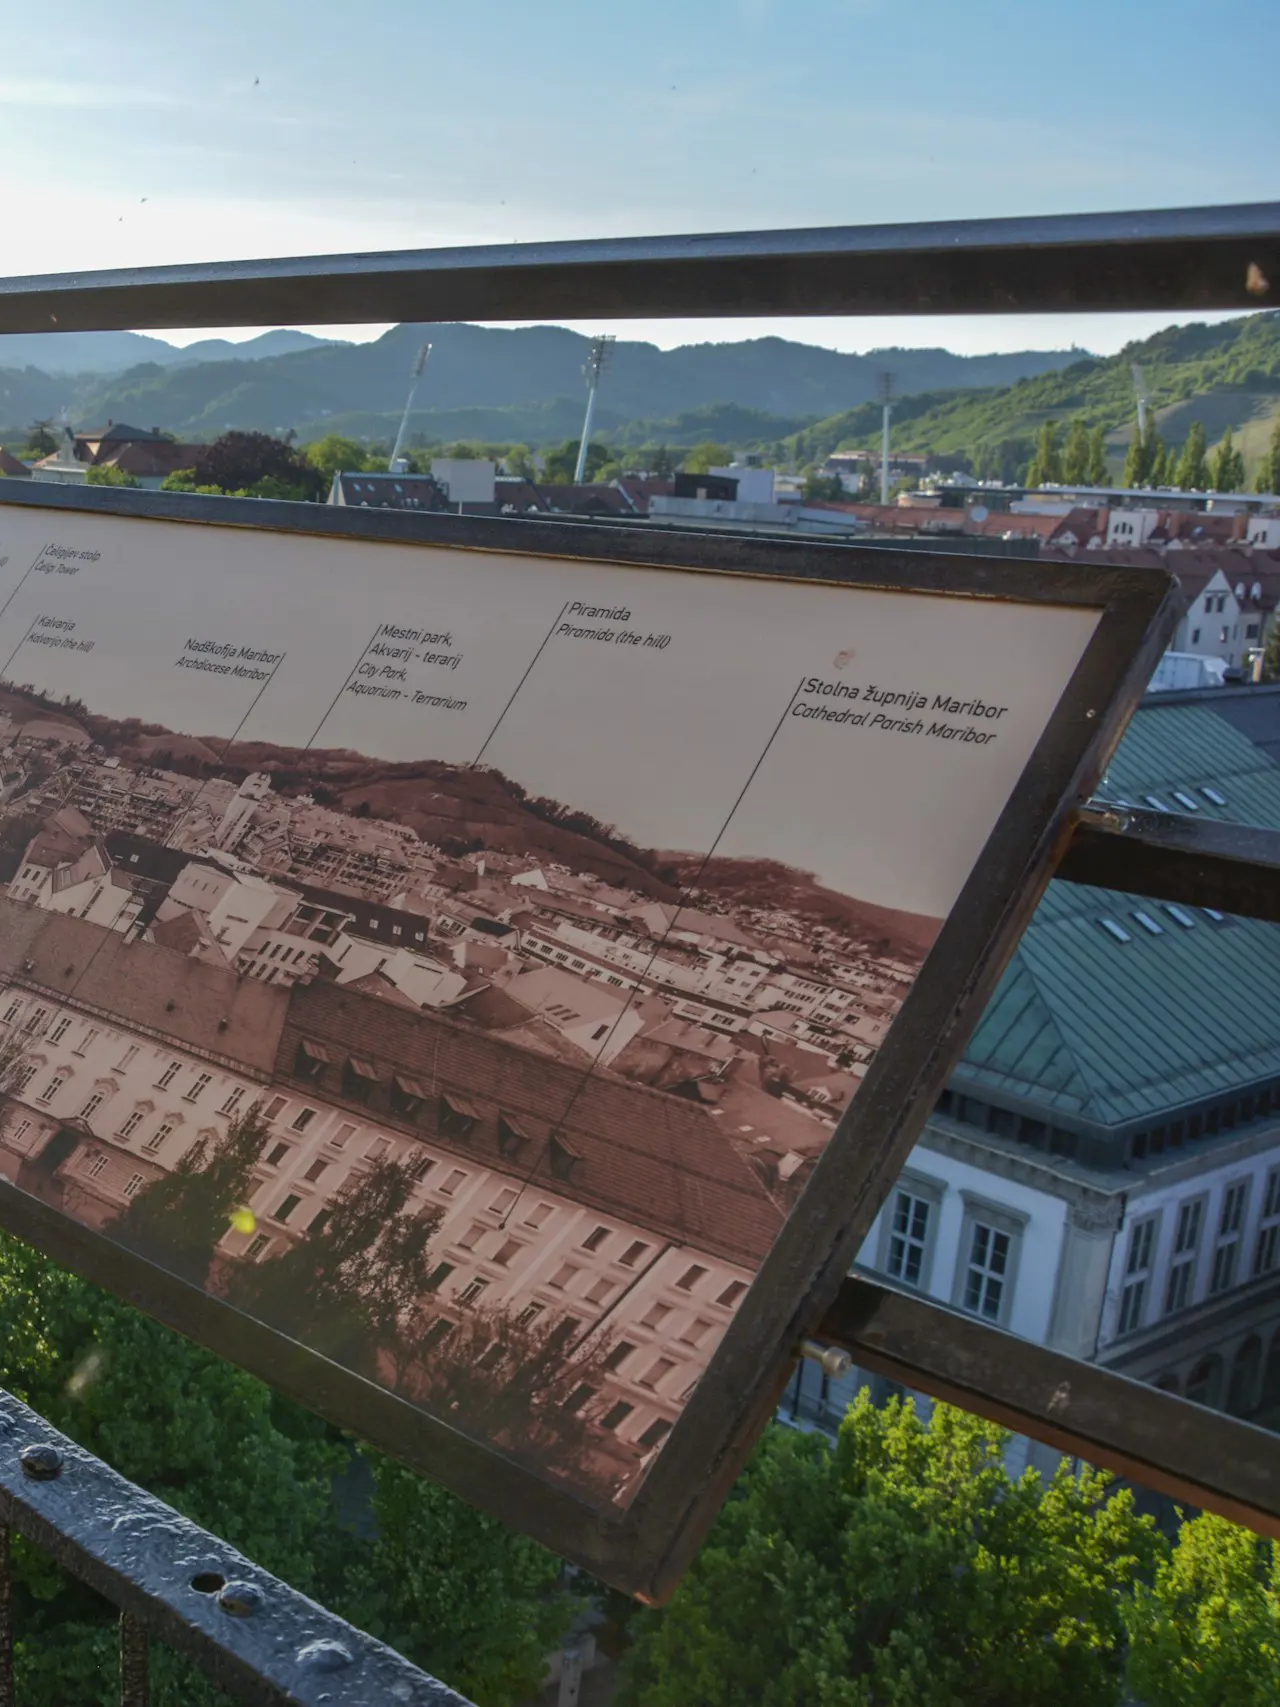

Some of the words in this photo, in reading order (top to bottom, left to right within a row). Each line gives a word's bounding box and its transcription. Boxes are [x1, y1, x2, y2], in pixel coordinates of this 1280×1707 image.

[78, 549, 102, 562] stolp
[56, 563, 81, 575] Tower
[568, 601, 631, 621] Piramida
[37, 615, 76, 633] Kalvarija
[380, 624, 423, 641] Mestni
[420, 631, 453, 647] park,
[26, 632, 62, 648] Kalvarija
[60, 636, 78, 651] (the
[77, 640, 97, 654] hill)
[555, 623, 615, 642] Piramida
[615, 630, 642, 646] (the
[642, 632, 671, 650] hill)
[183, 637, 237, 659] Nadškofija
[236, 646, 281, 665] Maribor
[368, 642, 414, 663] Akvarij
[422, 652, 463, 671] terarij
[174, 656, 231, 675] Archdiocese
[230, 665, 271, 681] Maribor
[358, 662, 380, 679] City
[378, 665, 407, 682] Park,
[346, 680, 401, 700] Aquarium
[410, 690, 468, 711] Terrarium
[803, 677, 860, 700] Stolna
[862, 684, 928, 711] župnija
[931, 694, 1009, 720] Maribor
[791, 702, 871, 727] Cathedral
[868, 713, 924, 735] Parish
[925, 721, 998, 745] Maribor
